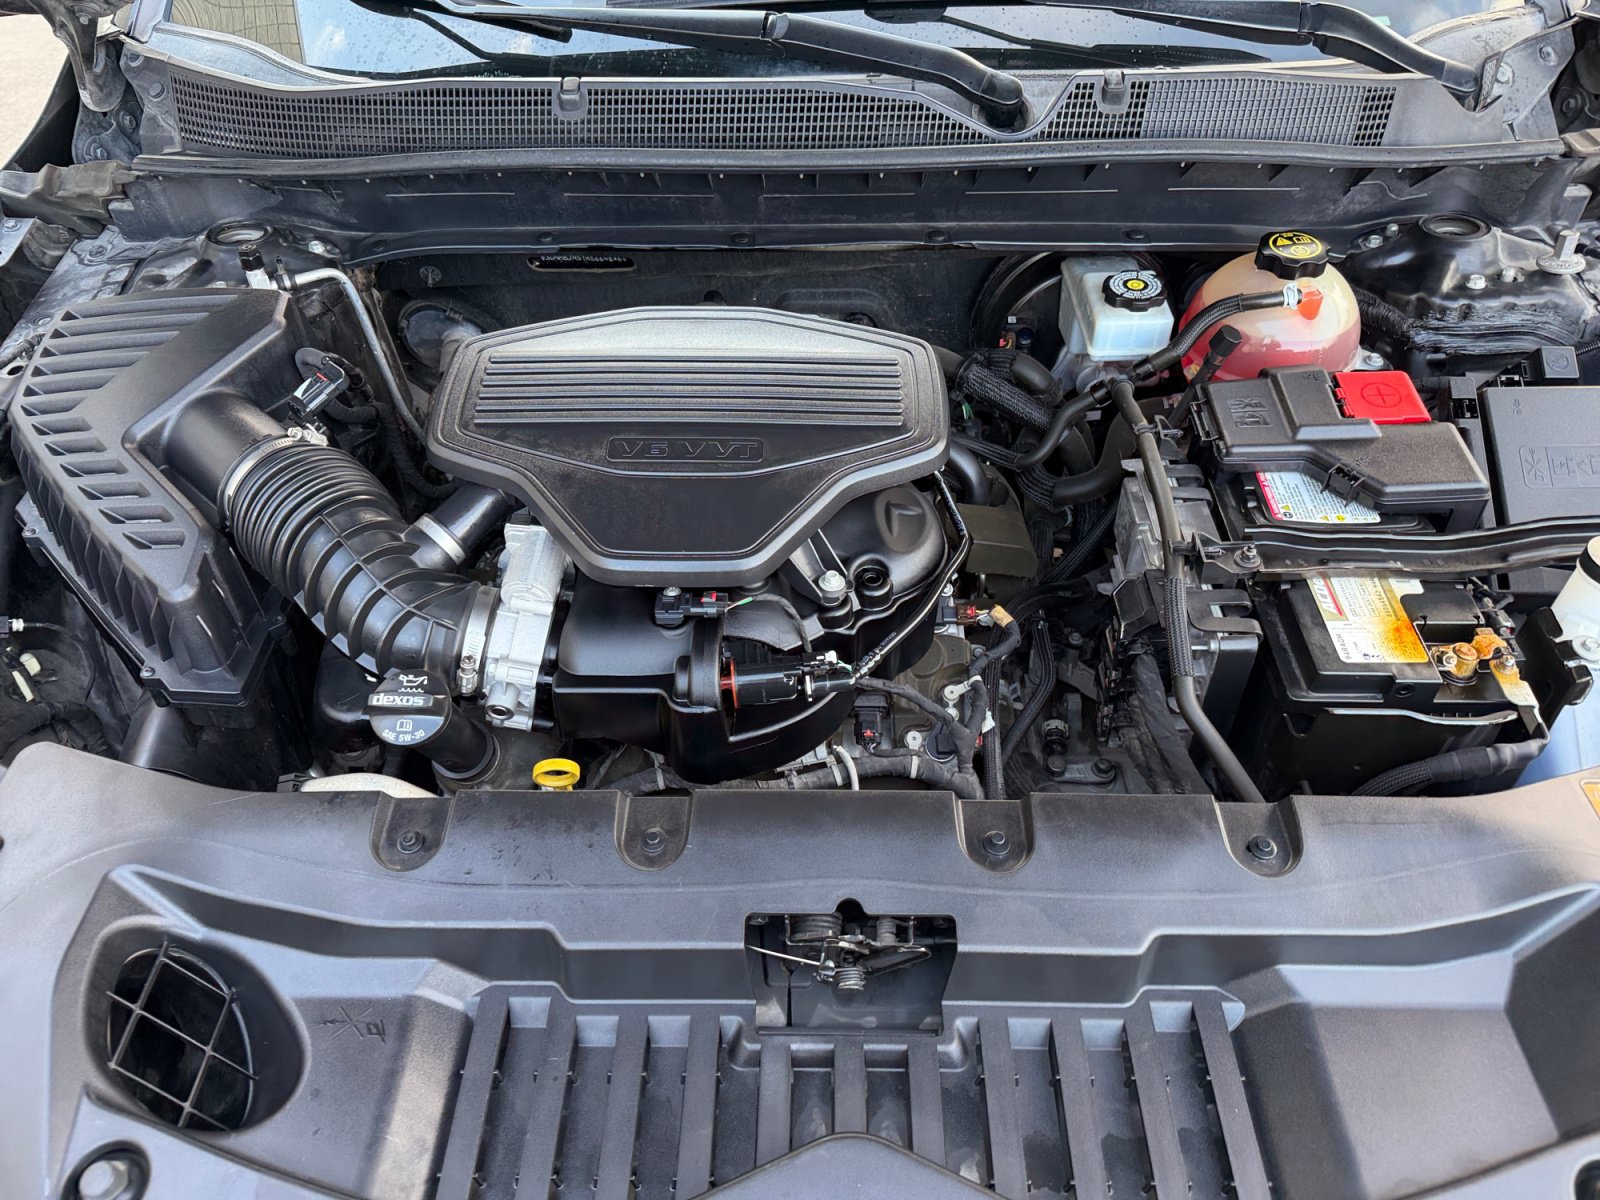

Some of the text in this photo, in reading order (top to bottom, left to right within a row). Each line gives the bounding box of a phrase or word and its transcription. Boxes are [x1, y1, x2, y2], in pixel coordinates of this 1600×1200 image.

[615, 441, 758, 458] V6 VVT
[372, 693, 425, 706] dexos
[382, 729, 425, 742] SAE 5W-30
